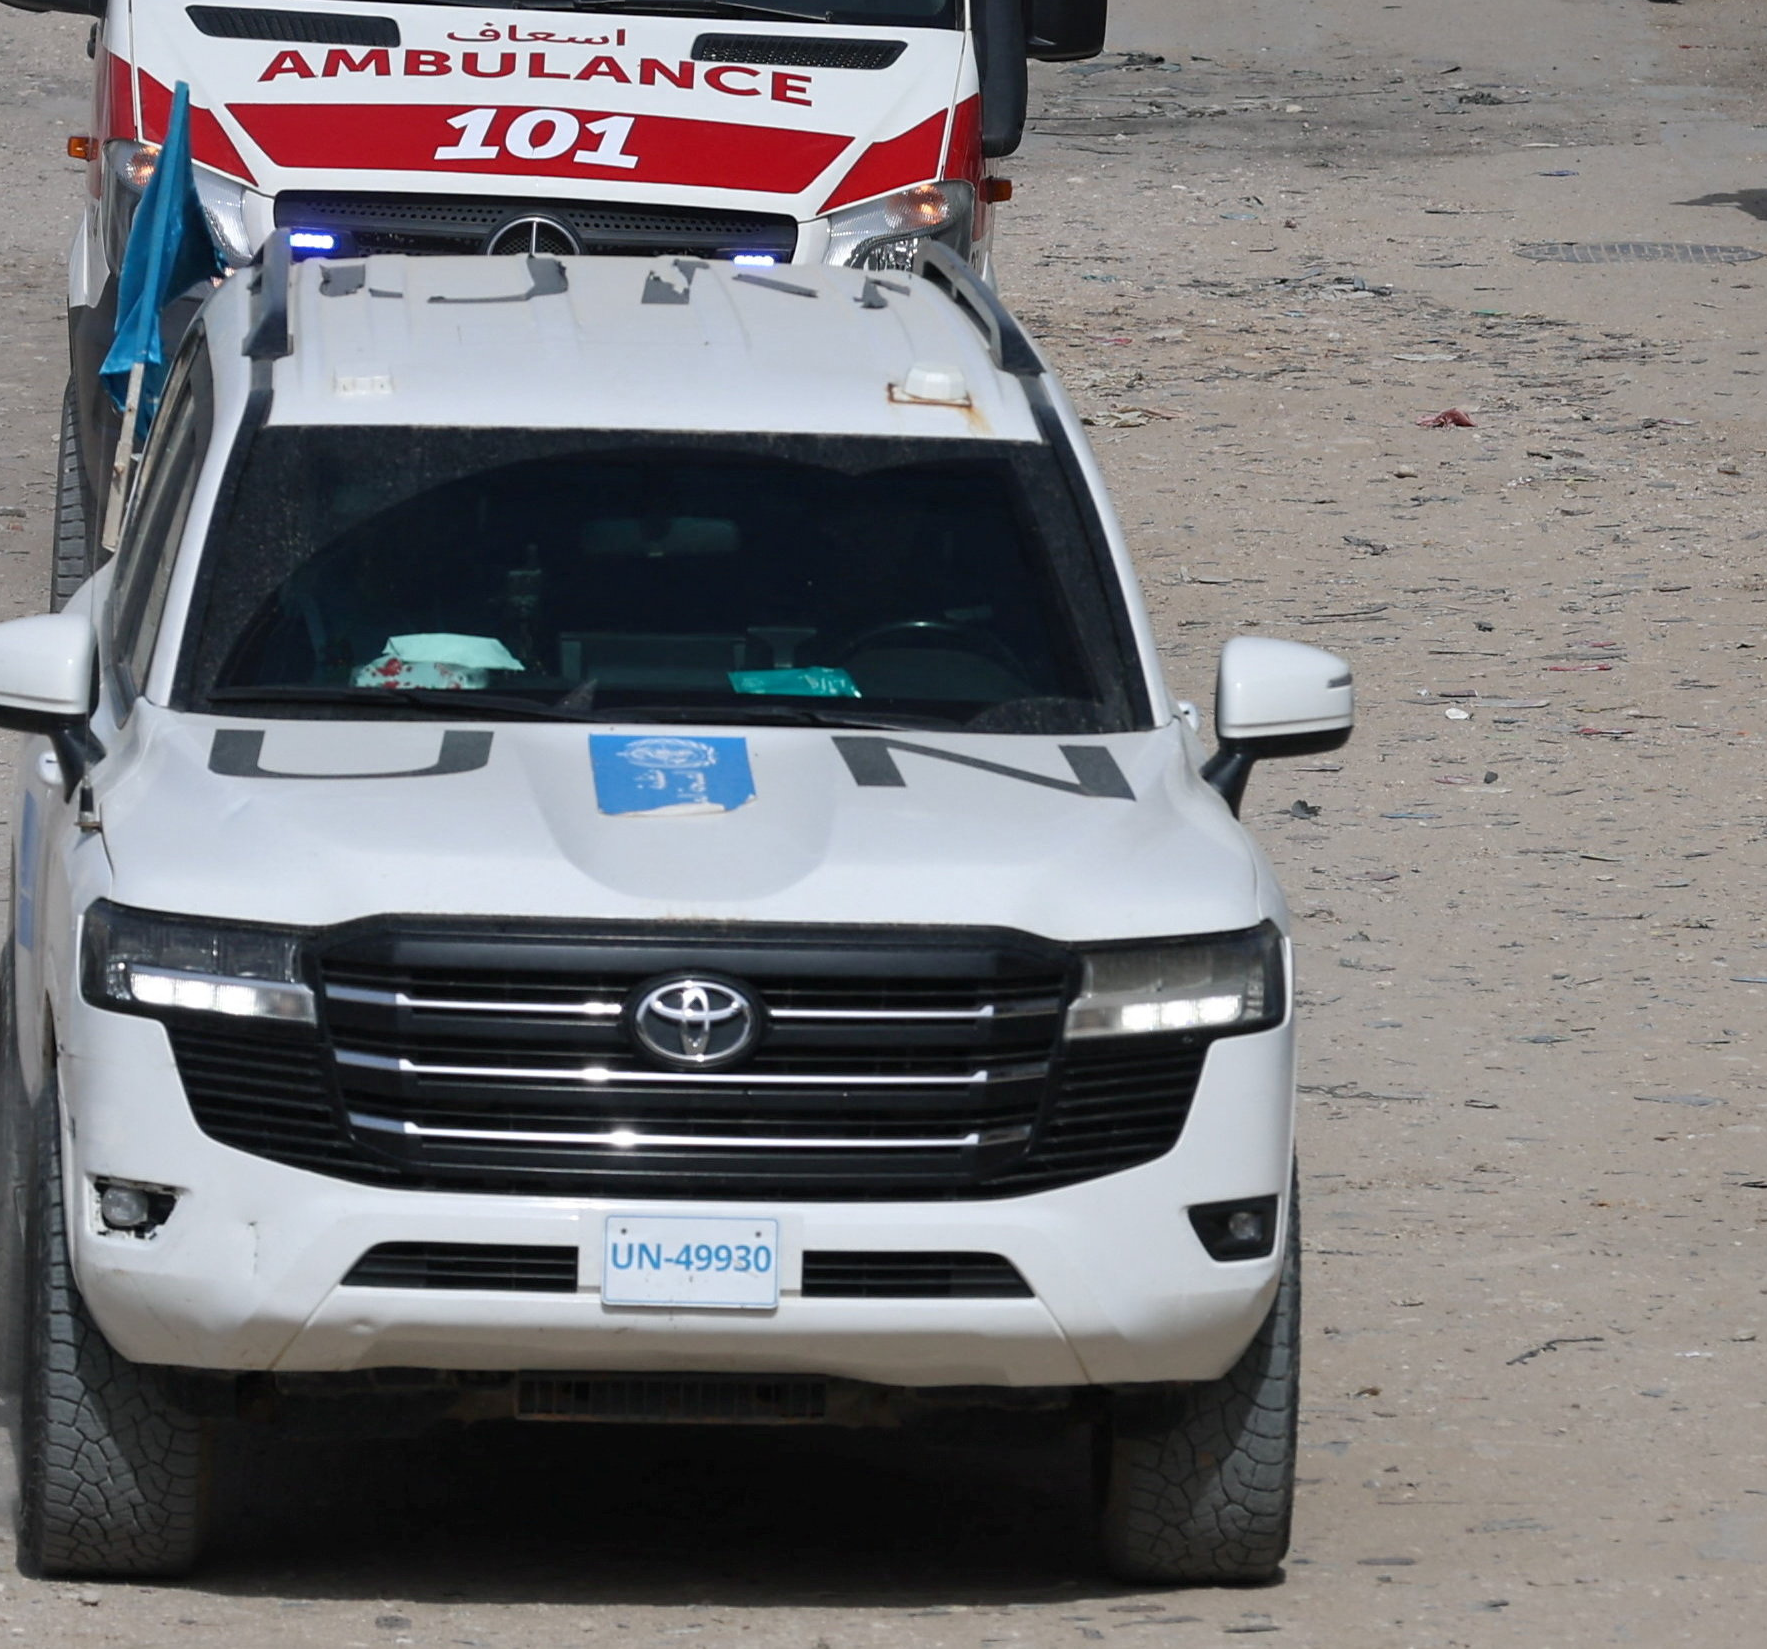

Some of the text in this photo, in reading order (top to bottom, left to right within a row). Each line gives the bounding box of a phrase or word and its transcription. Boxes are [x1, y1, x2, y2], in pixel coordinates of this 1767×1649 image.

[445, 21, 627, 48] اسعاف
[256, 47, 814, 108] AMBULANCE
[433, 107, 640, 170] 101
[610, 1242, 772, 1274] UN-49930
